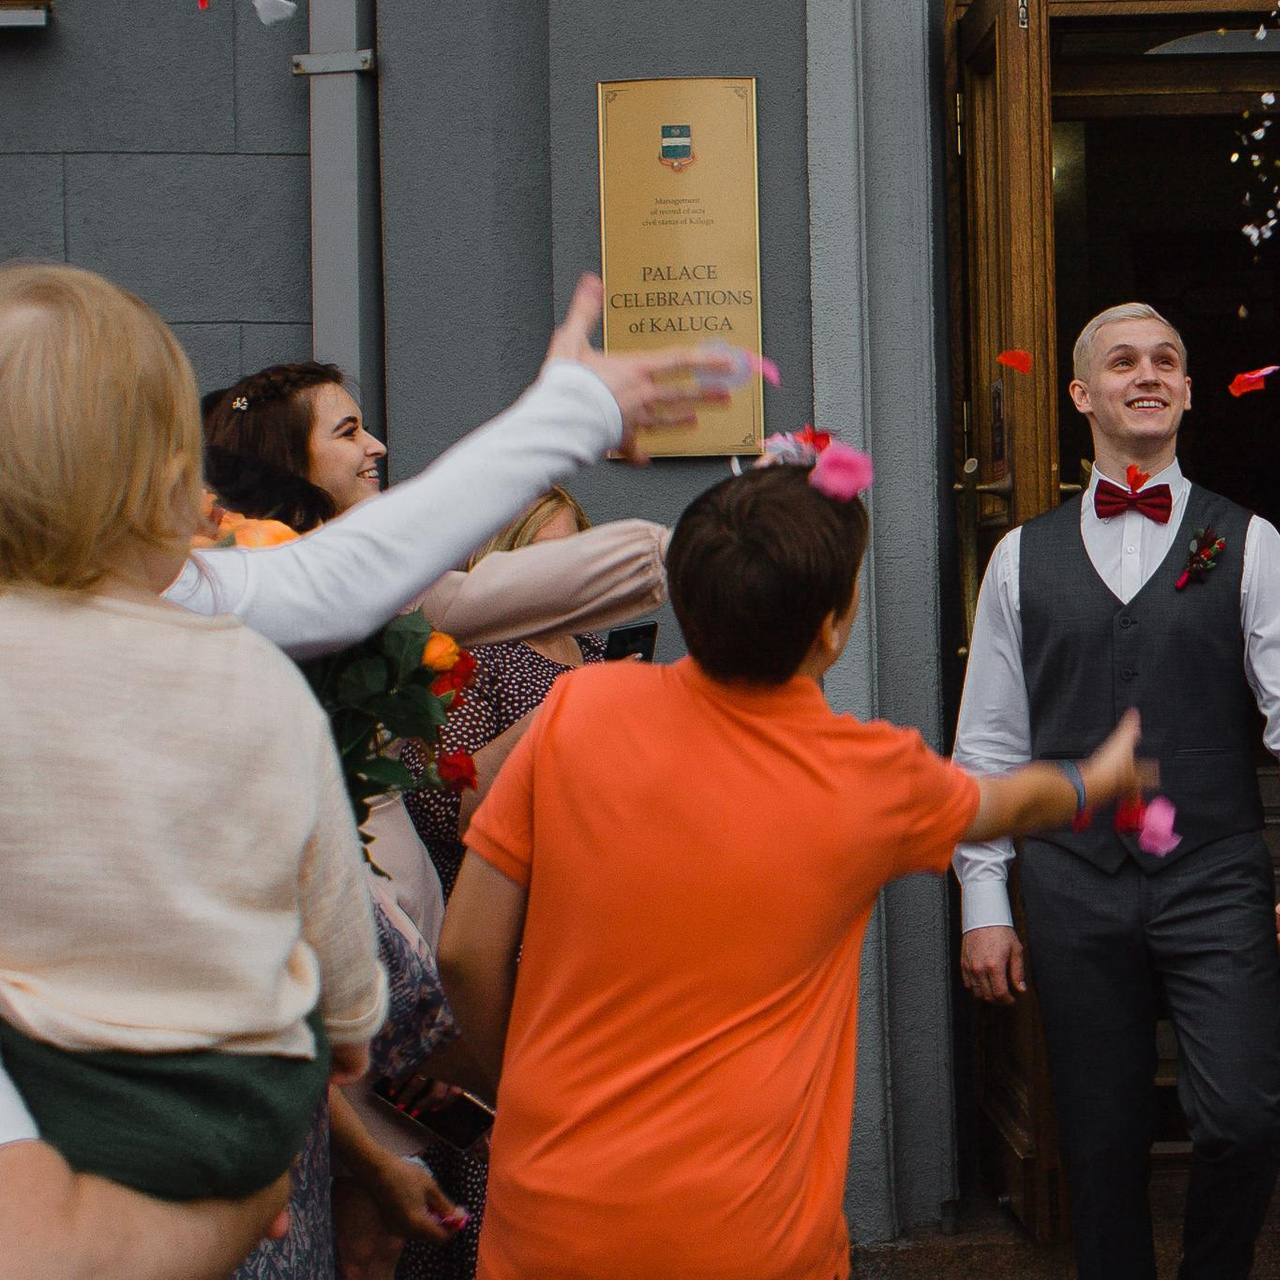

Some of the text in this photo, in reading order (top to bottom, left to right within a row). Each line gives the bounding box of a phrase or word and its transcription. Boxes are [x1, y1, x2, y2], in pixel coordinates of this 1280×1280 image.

[641, 265, 718, 282] PALACE
[610, 290, 753, 309] CELEBRATIONS
[629, 316, 733, 334] of KALUGA
